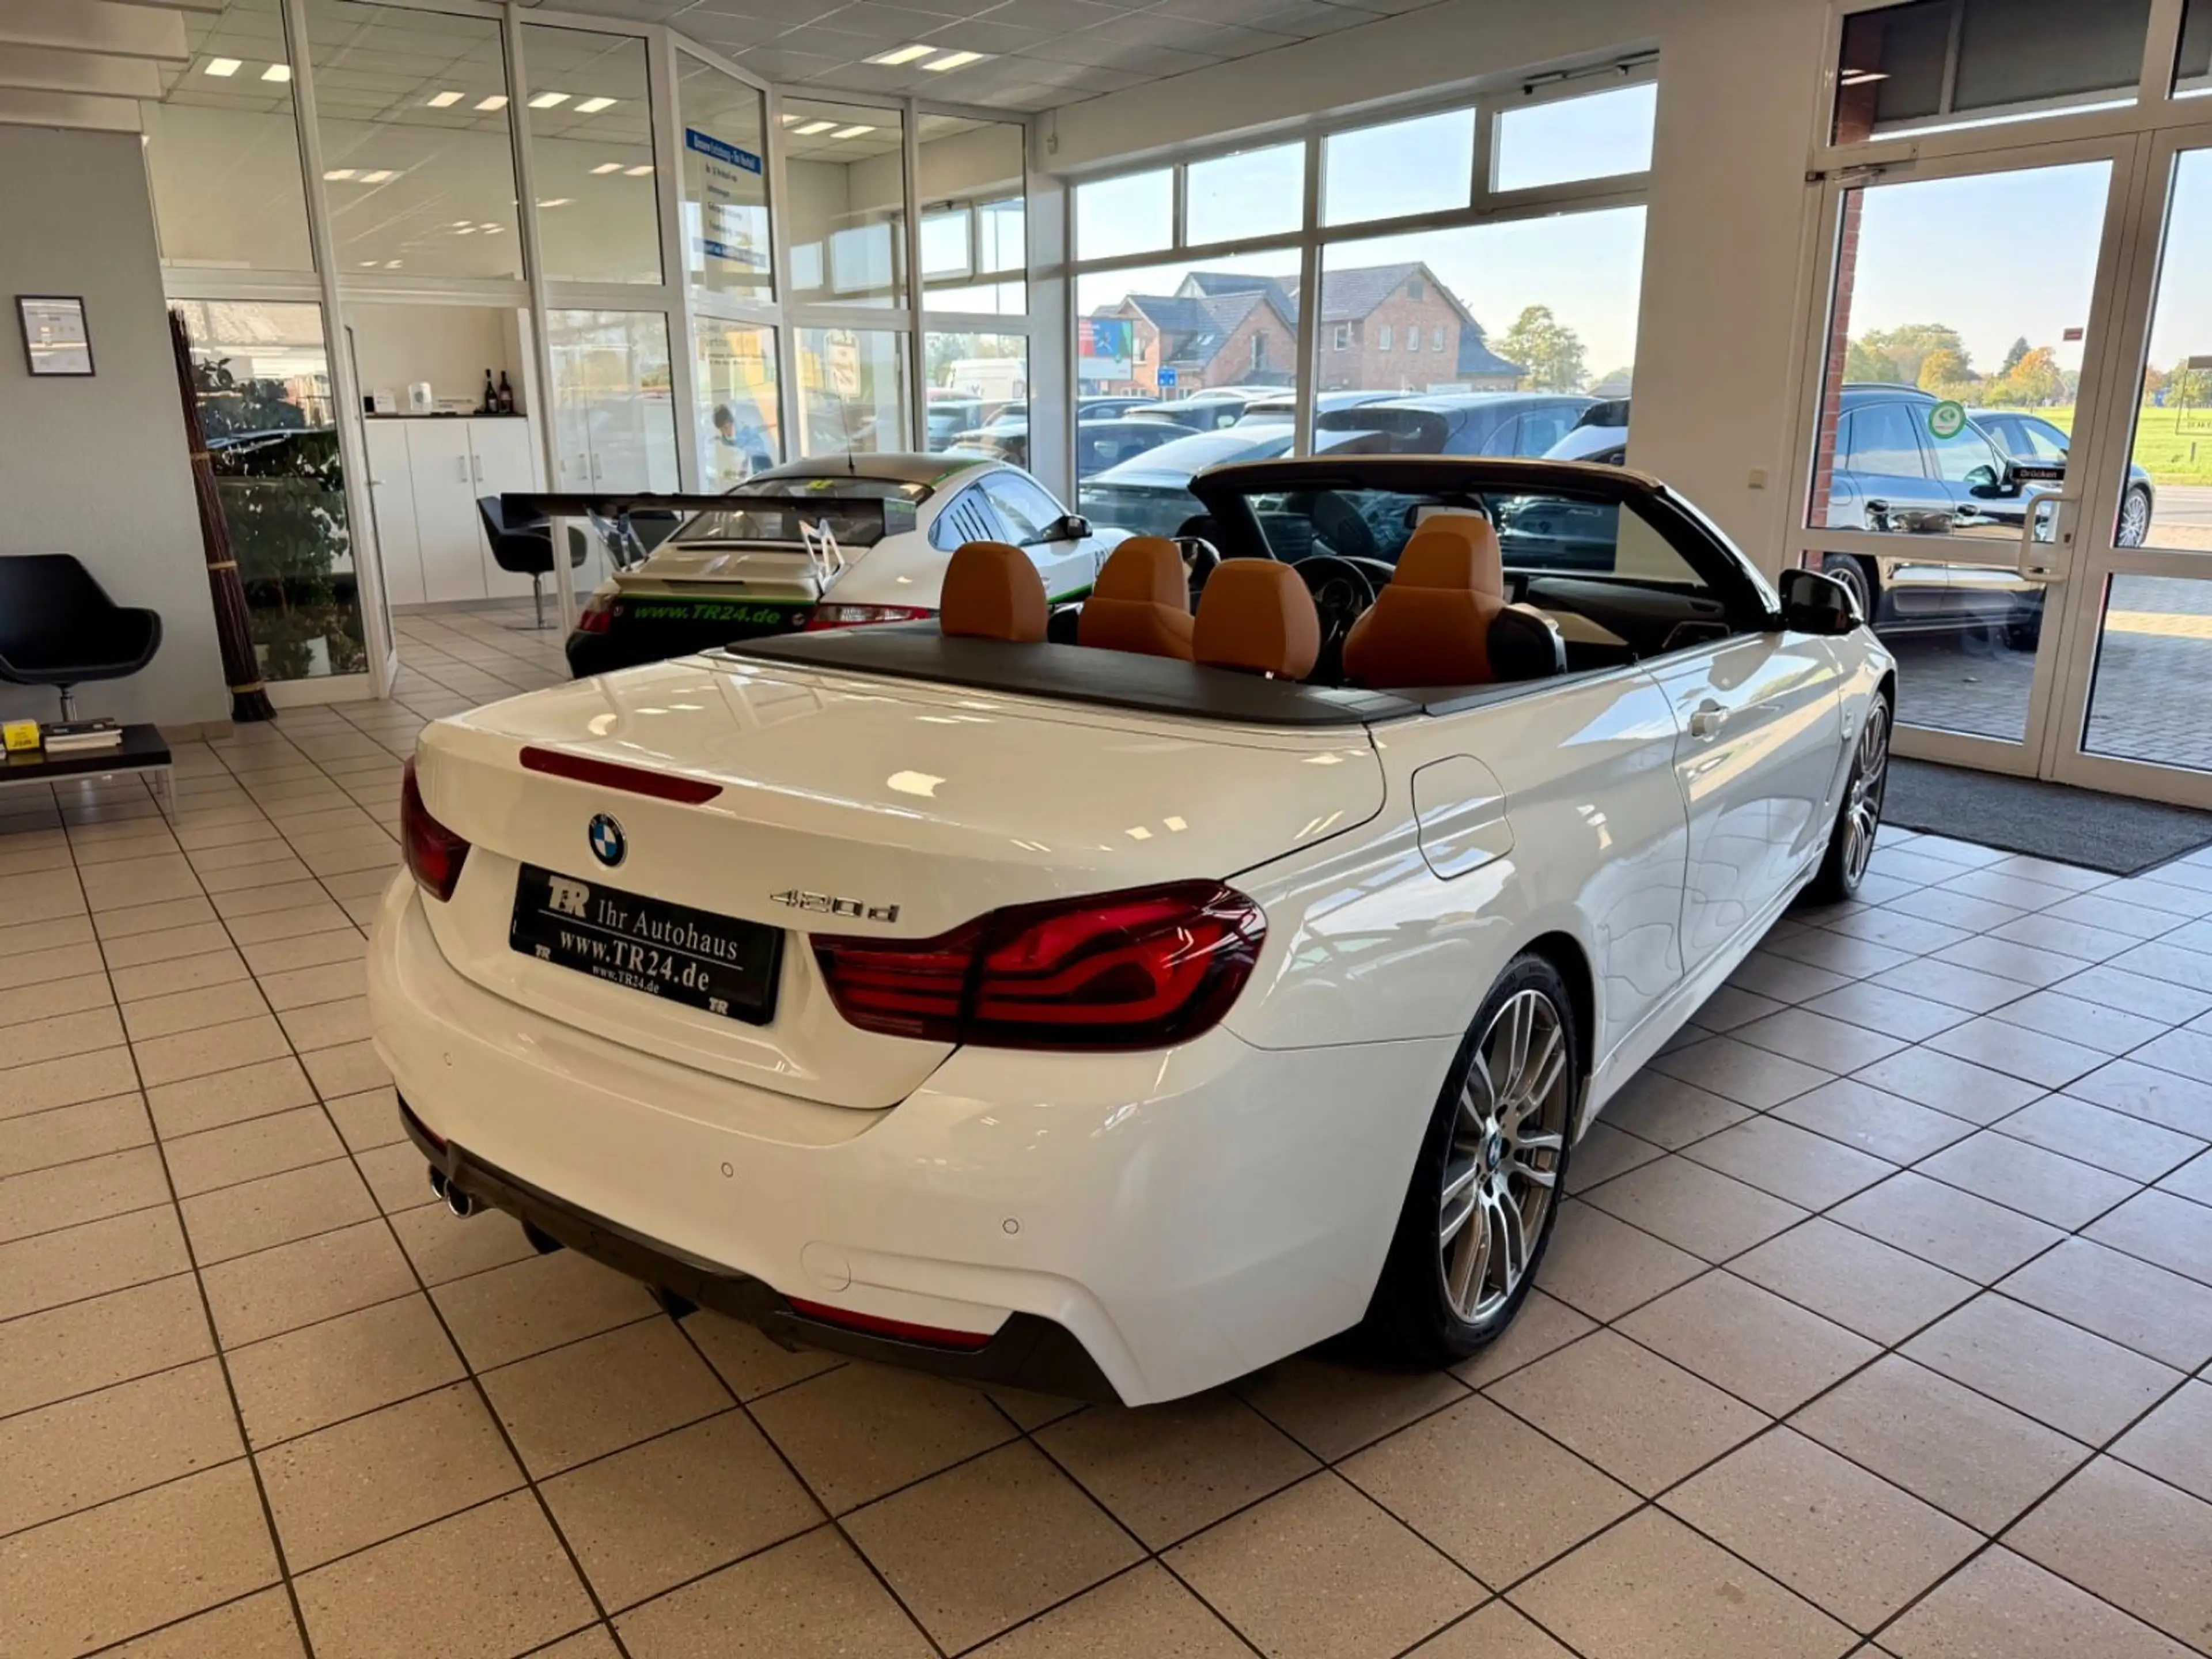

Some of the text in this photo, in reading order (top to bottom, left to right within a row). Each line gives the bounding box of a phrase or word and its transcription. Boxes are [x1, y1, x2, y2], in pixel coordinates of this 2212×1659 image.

[634, 604, 781, 624] www.TR24.de
[597, 899, 628, 930] Ihr
[632, 910, 739, 966] Autohaus
[560, 930, 710, 991] www.TR24.de
[592, 965, 660, 994] www.TR24.de
